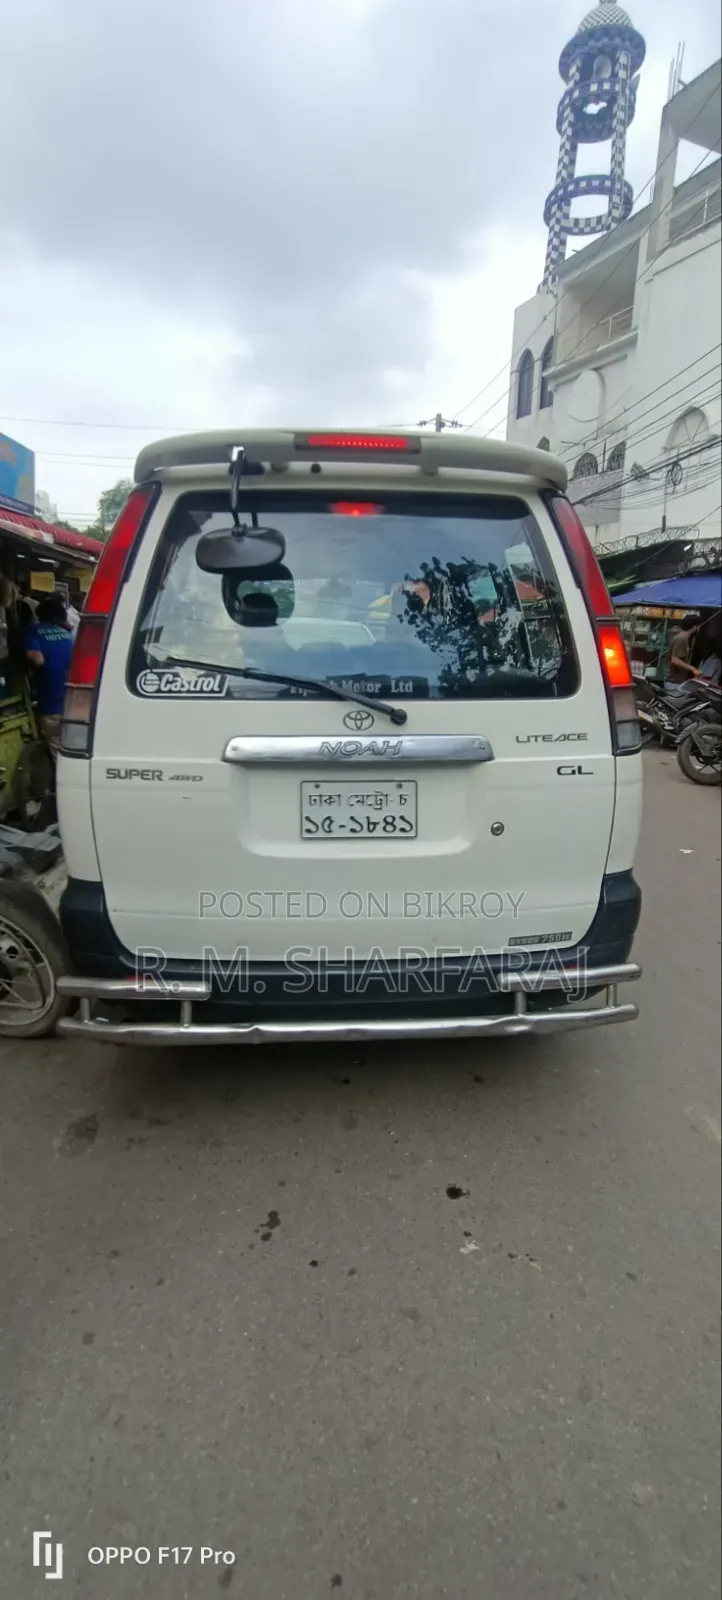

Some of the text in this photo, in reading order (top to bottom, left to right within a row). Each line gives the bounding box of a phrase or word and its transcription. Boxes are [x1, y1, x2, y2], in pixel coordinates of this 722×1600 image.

[160, 673, 221, 692] Castrol
[341, 679, 381, 693] Motor
[391, 679, 413, 693] Ltd
[515, 732, 588, 743] LITEACE
[319, 740, 402, 756] NOAH
[105, 768, 164, 781] SUPER
[556, 765, 594, 776] GL
[308, 793, 341, 806] ঢাকা
[304, 814, 414, 834] ১৫-১৮৪১
